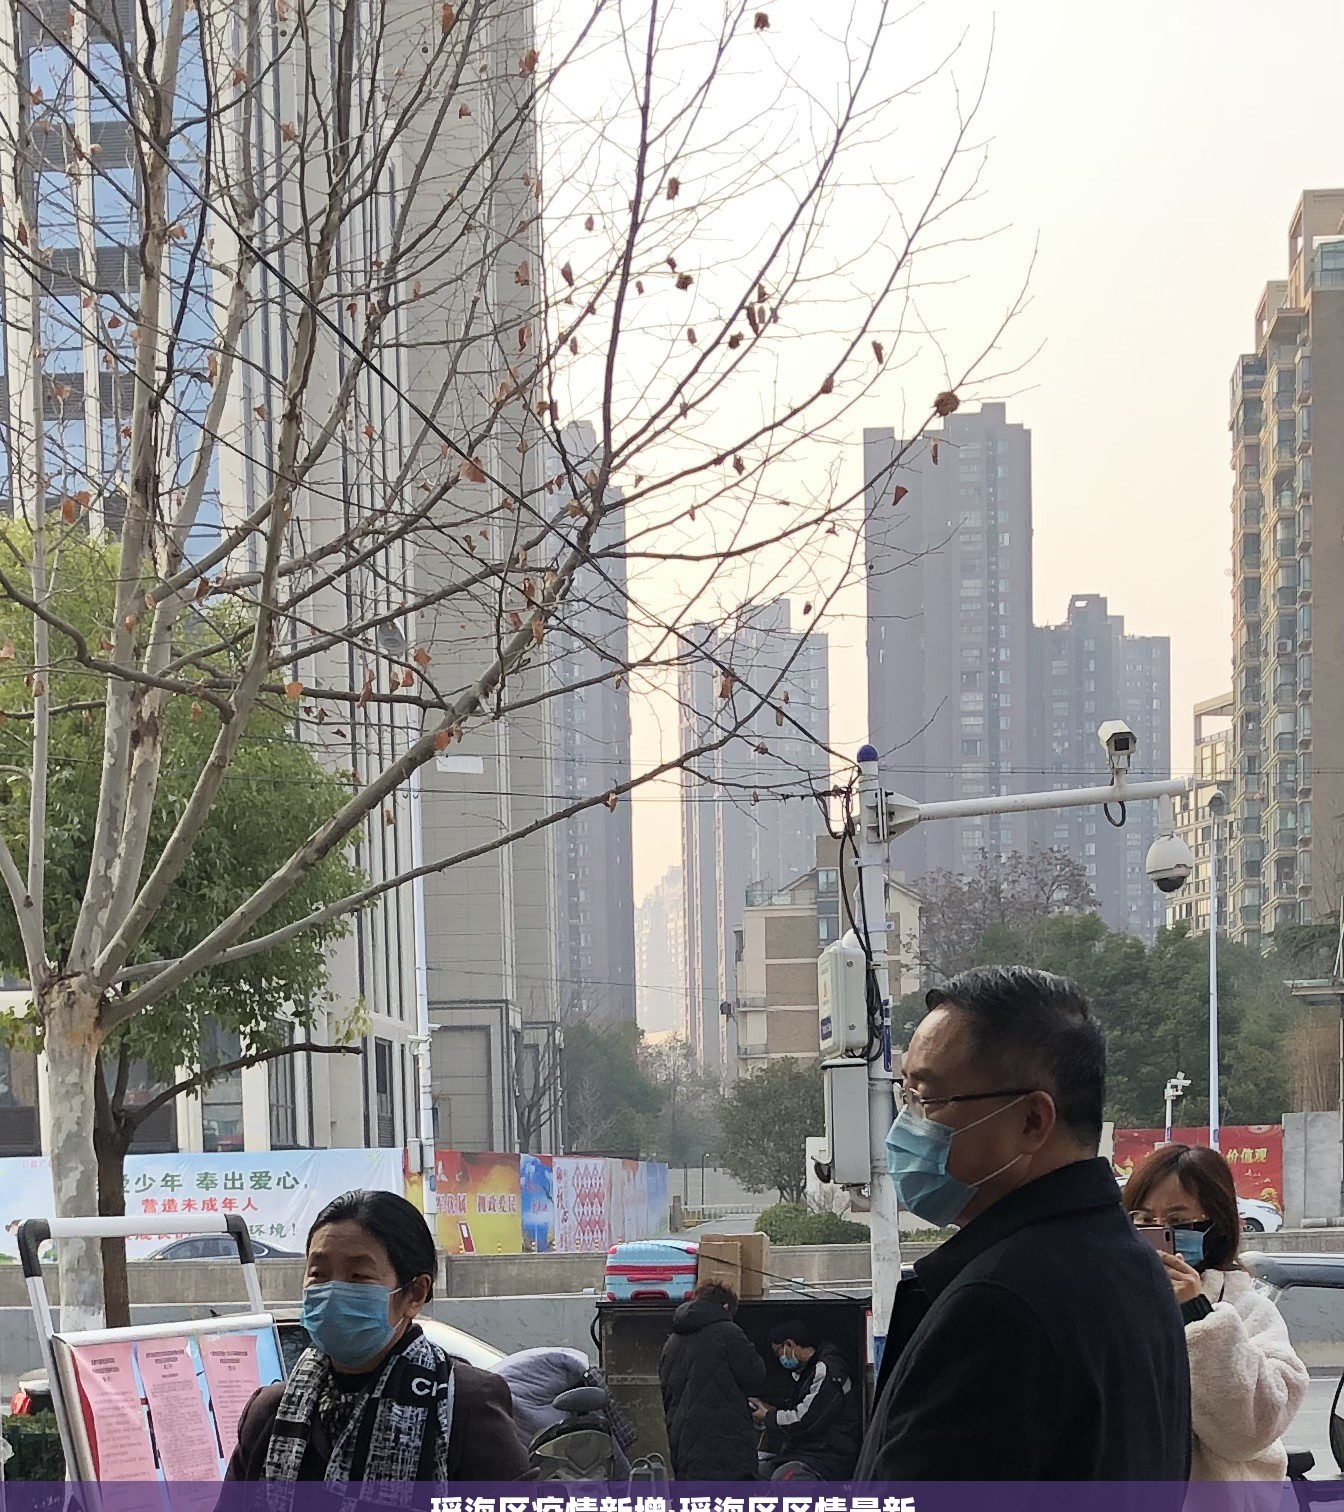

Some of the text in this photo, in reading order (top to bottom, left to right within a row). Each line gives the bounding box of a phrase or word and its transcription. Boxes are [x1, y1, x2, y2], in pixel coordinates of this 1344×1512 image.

[141, 1197, 259, 1215] 营造未成年人
